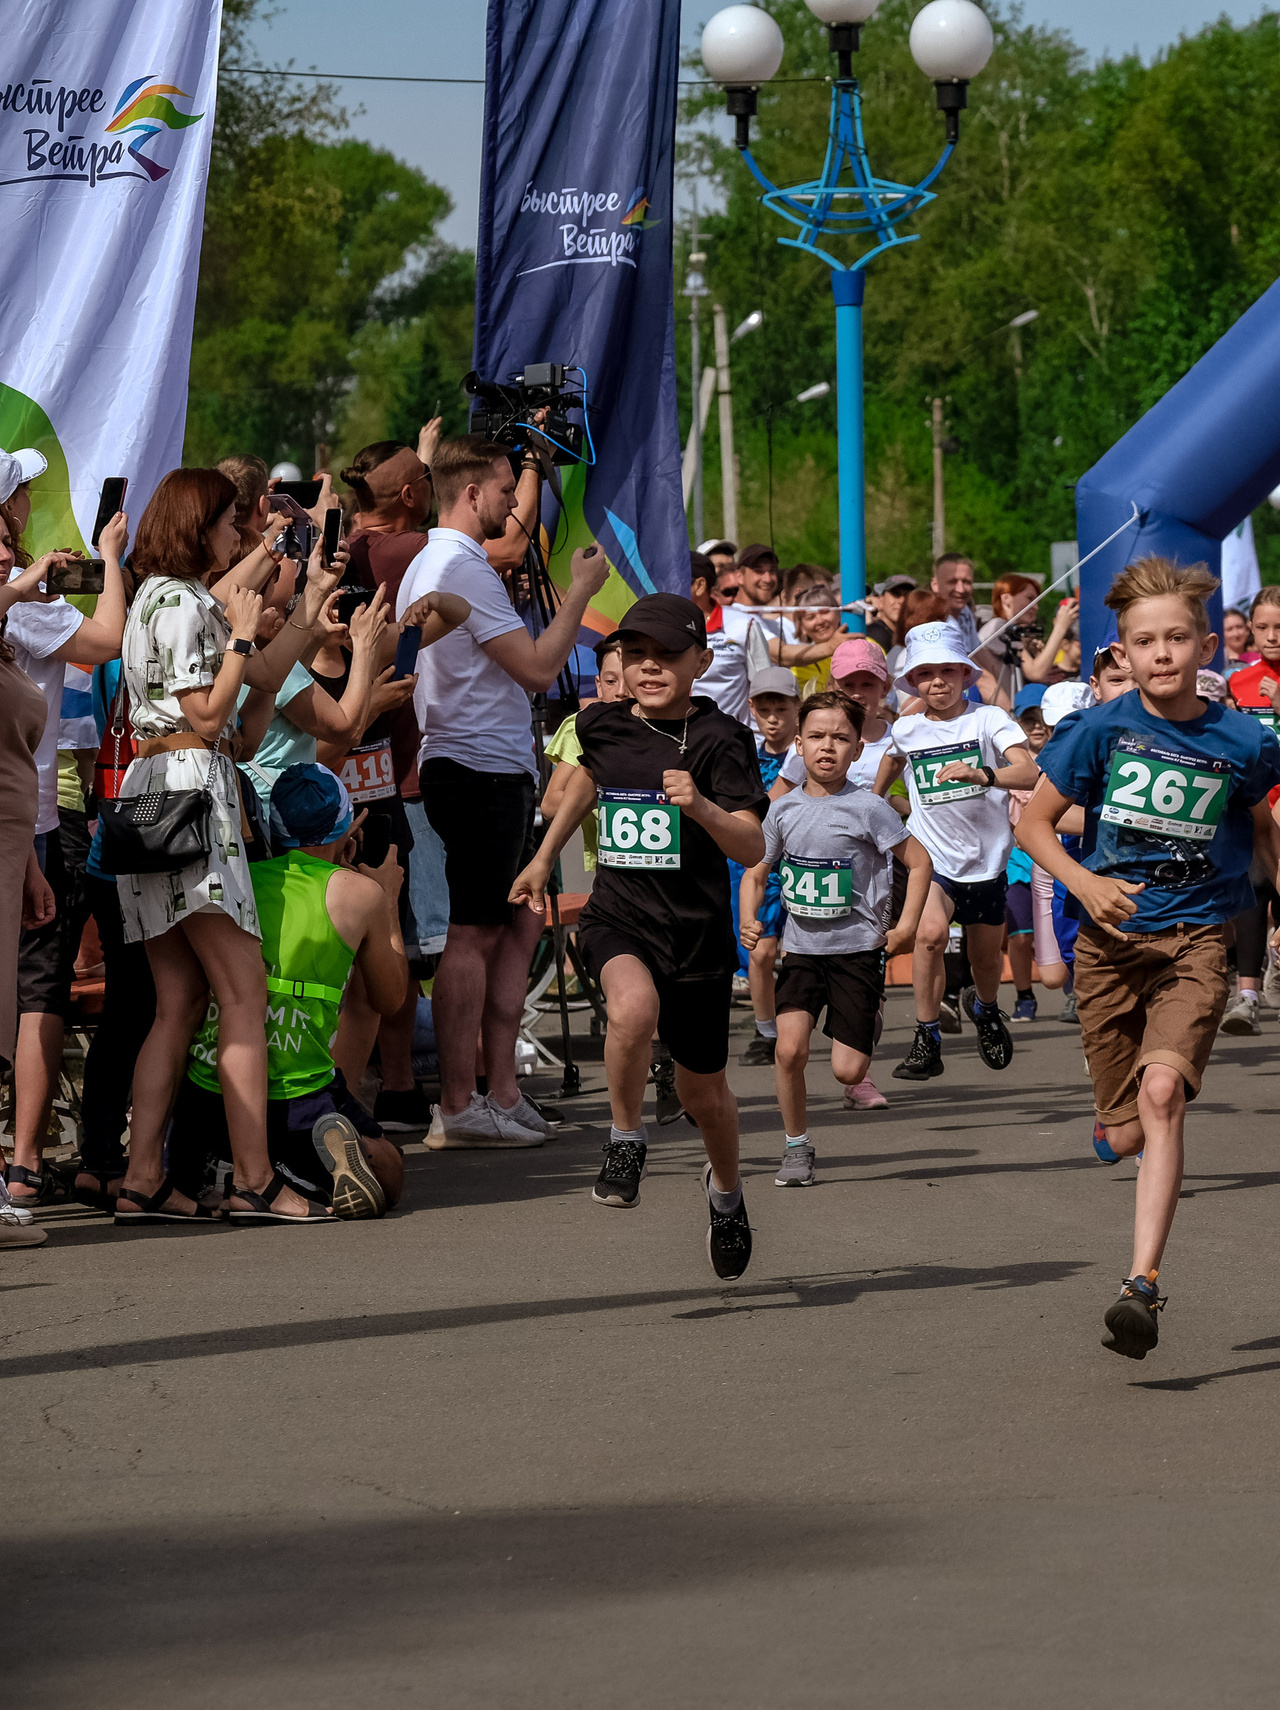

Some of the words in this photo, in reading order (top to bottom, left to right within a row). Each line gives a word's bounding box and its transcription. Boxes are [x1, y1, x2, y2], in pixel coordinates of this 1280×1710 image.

[0, 79, 107, 132] ыстрее
[23, 128, 125, 188] Ветра
[520, 180, 621, 227] Быстрее
[559, 223, 635, 267] Ветра
[339, 753, 393, 789] 419
[1111, 761, 1223, 820] 267
[599, 806, 672, 850] 168
[781, 865, 846, 904] 241
[266, 1030, 302, 1054] AN
